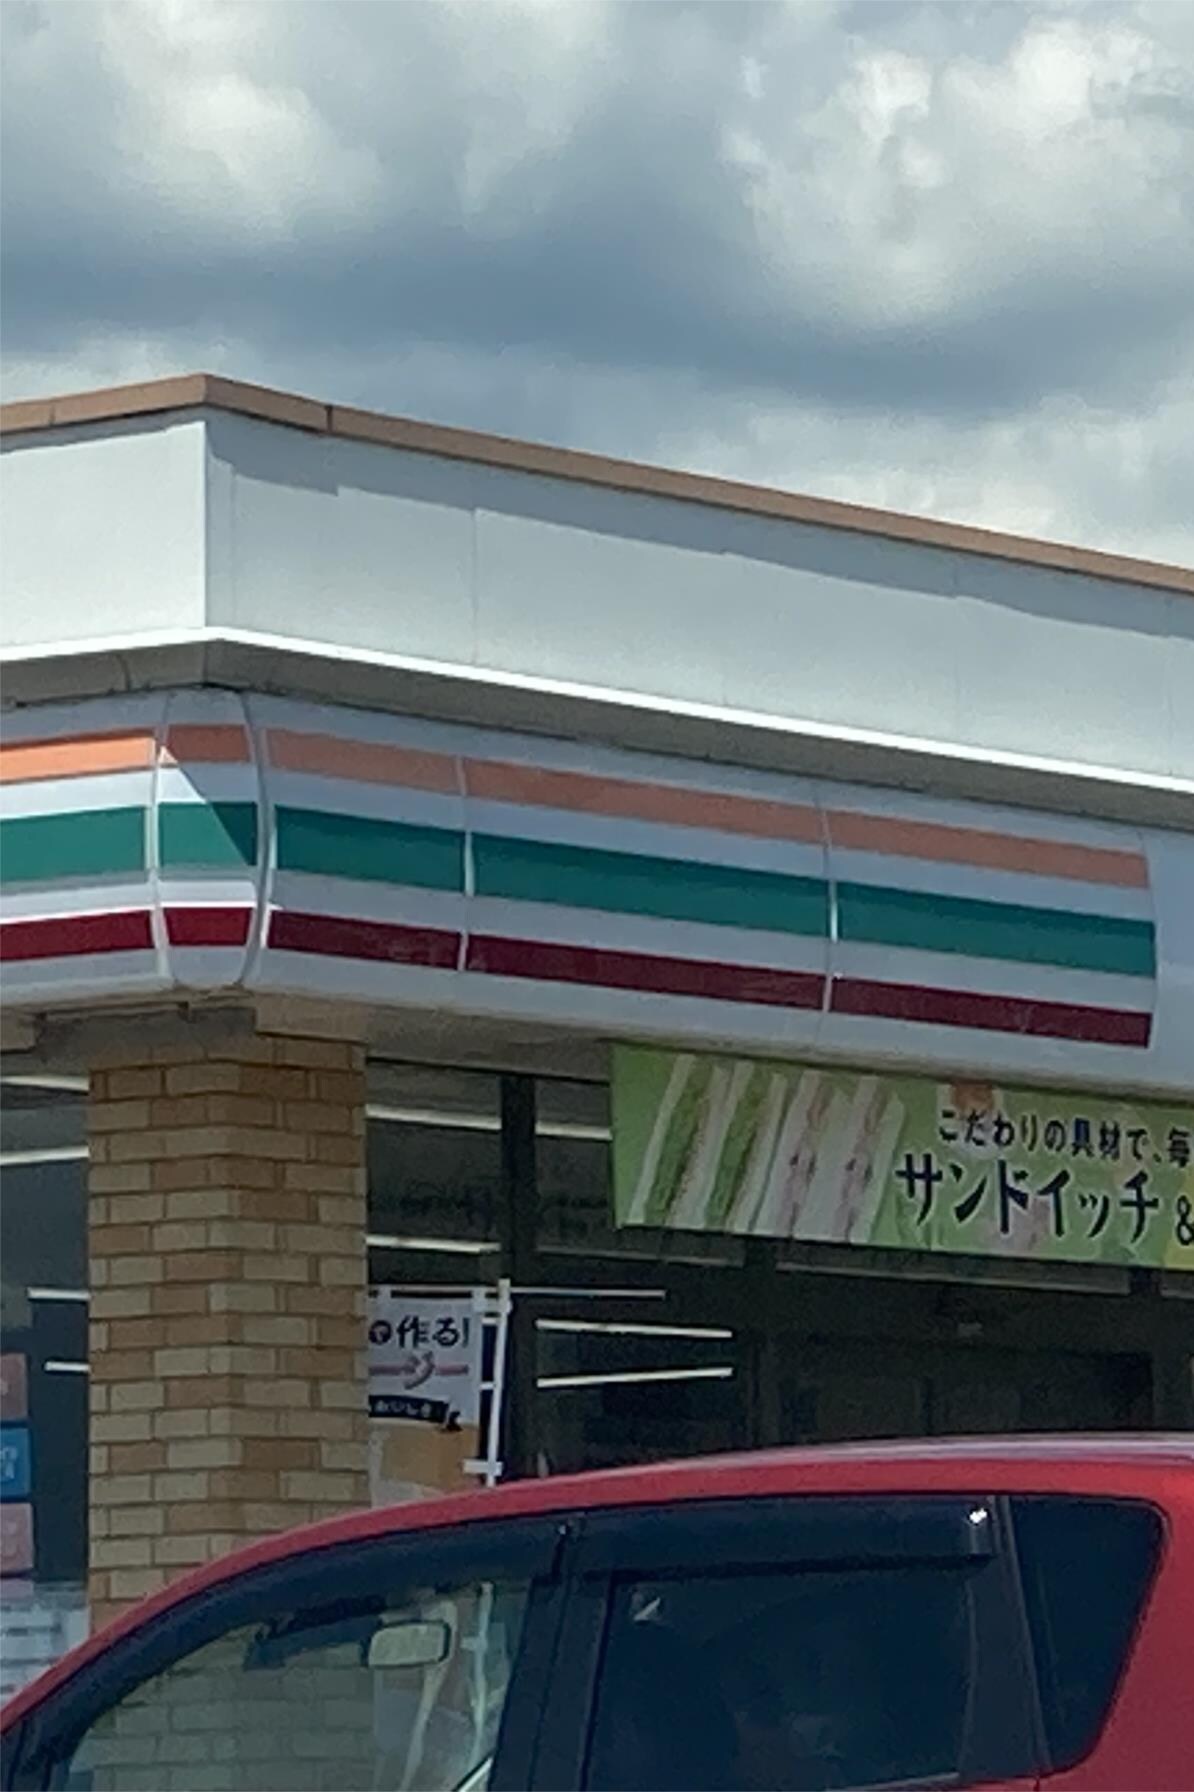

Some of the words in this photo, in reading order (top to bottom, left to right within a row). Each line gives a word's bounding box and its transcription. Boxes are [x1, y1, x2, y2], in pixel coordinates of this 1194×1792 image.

[895, 1152, 1160, 1243] サンドイッチ
